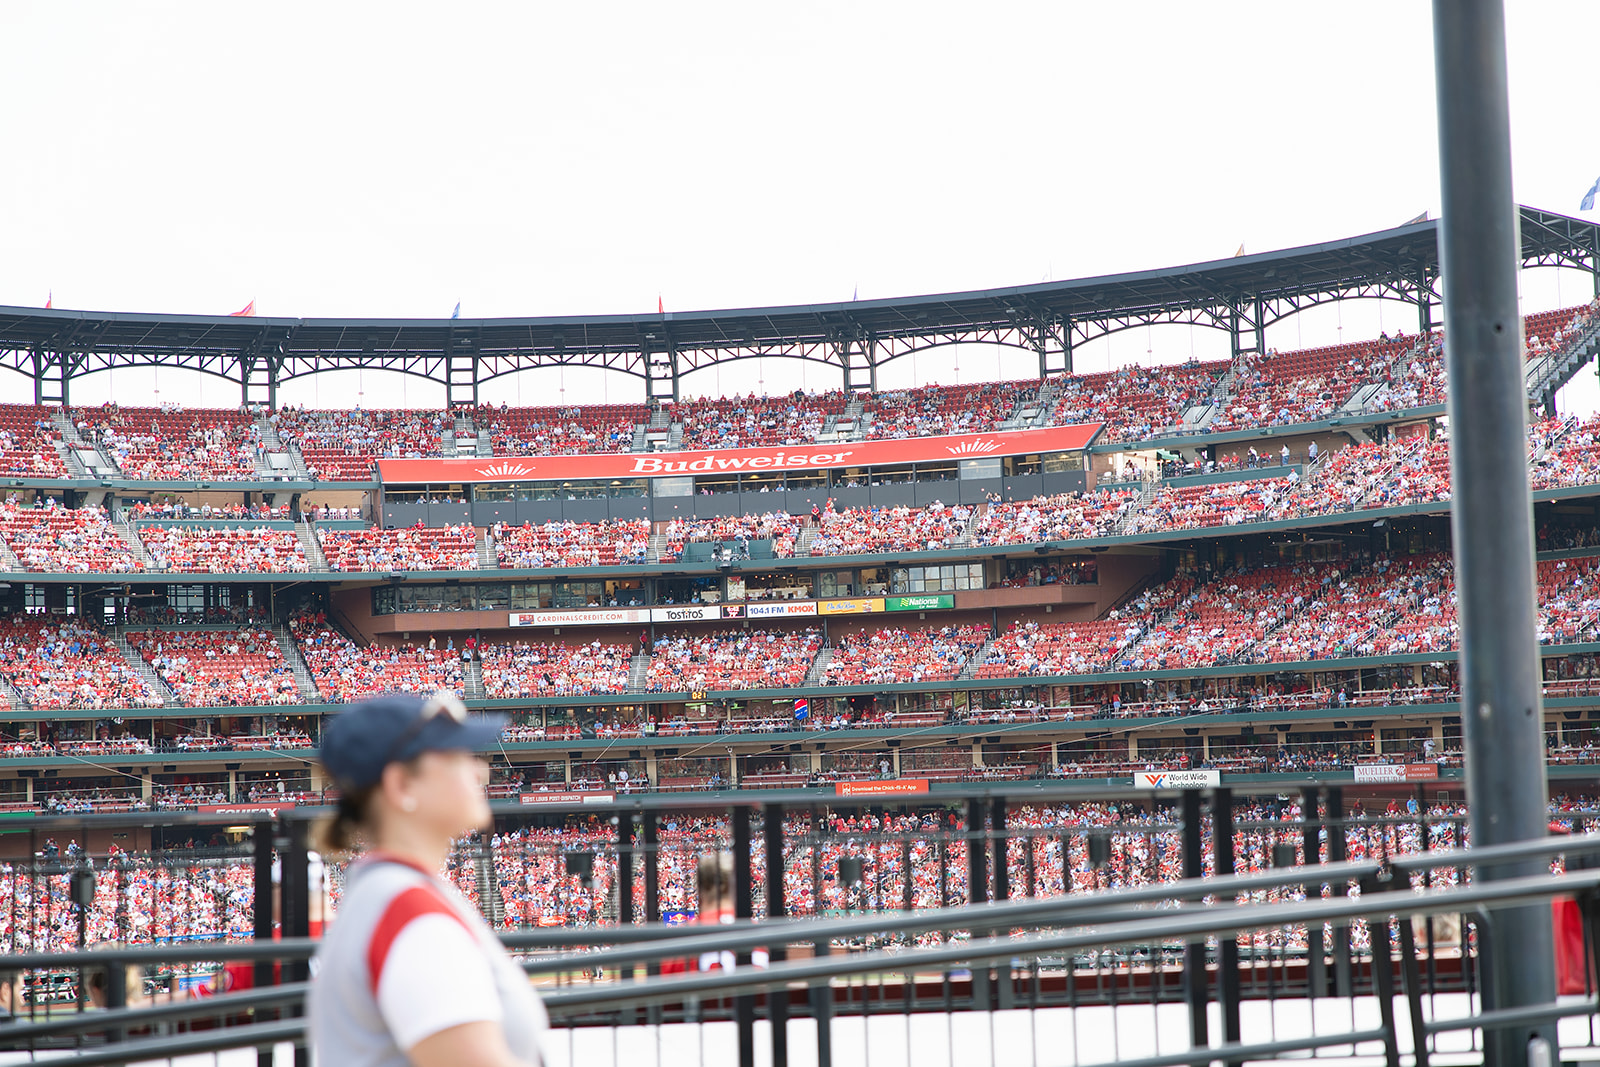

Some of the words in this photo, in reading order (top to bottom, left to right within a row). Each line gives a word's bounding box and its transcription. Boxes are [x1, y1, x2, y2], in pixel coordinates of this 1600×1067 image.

[629, 451, 853, 473] Budweiser
[909, 597, 939, 606] National
[536, 614, 623, 622] CARDINALSCREDIT.COM
[1358, 767, 1394, 776] MUELLER
